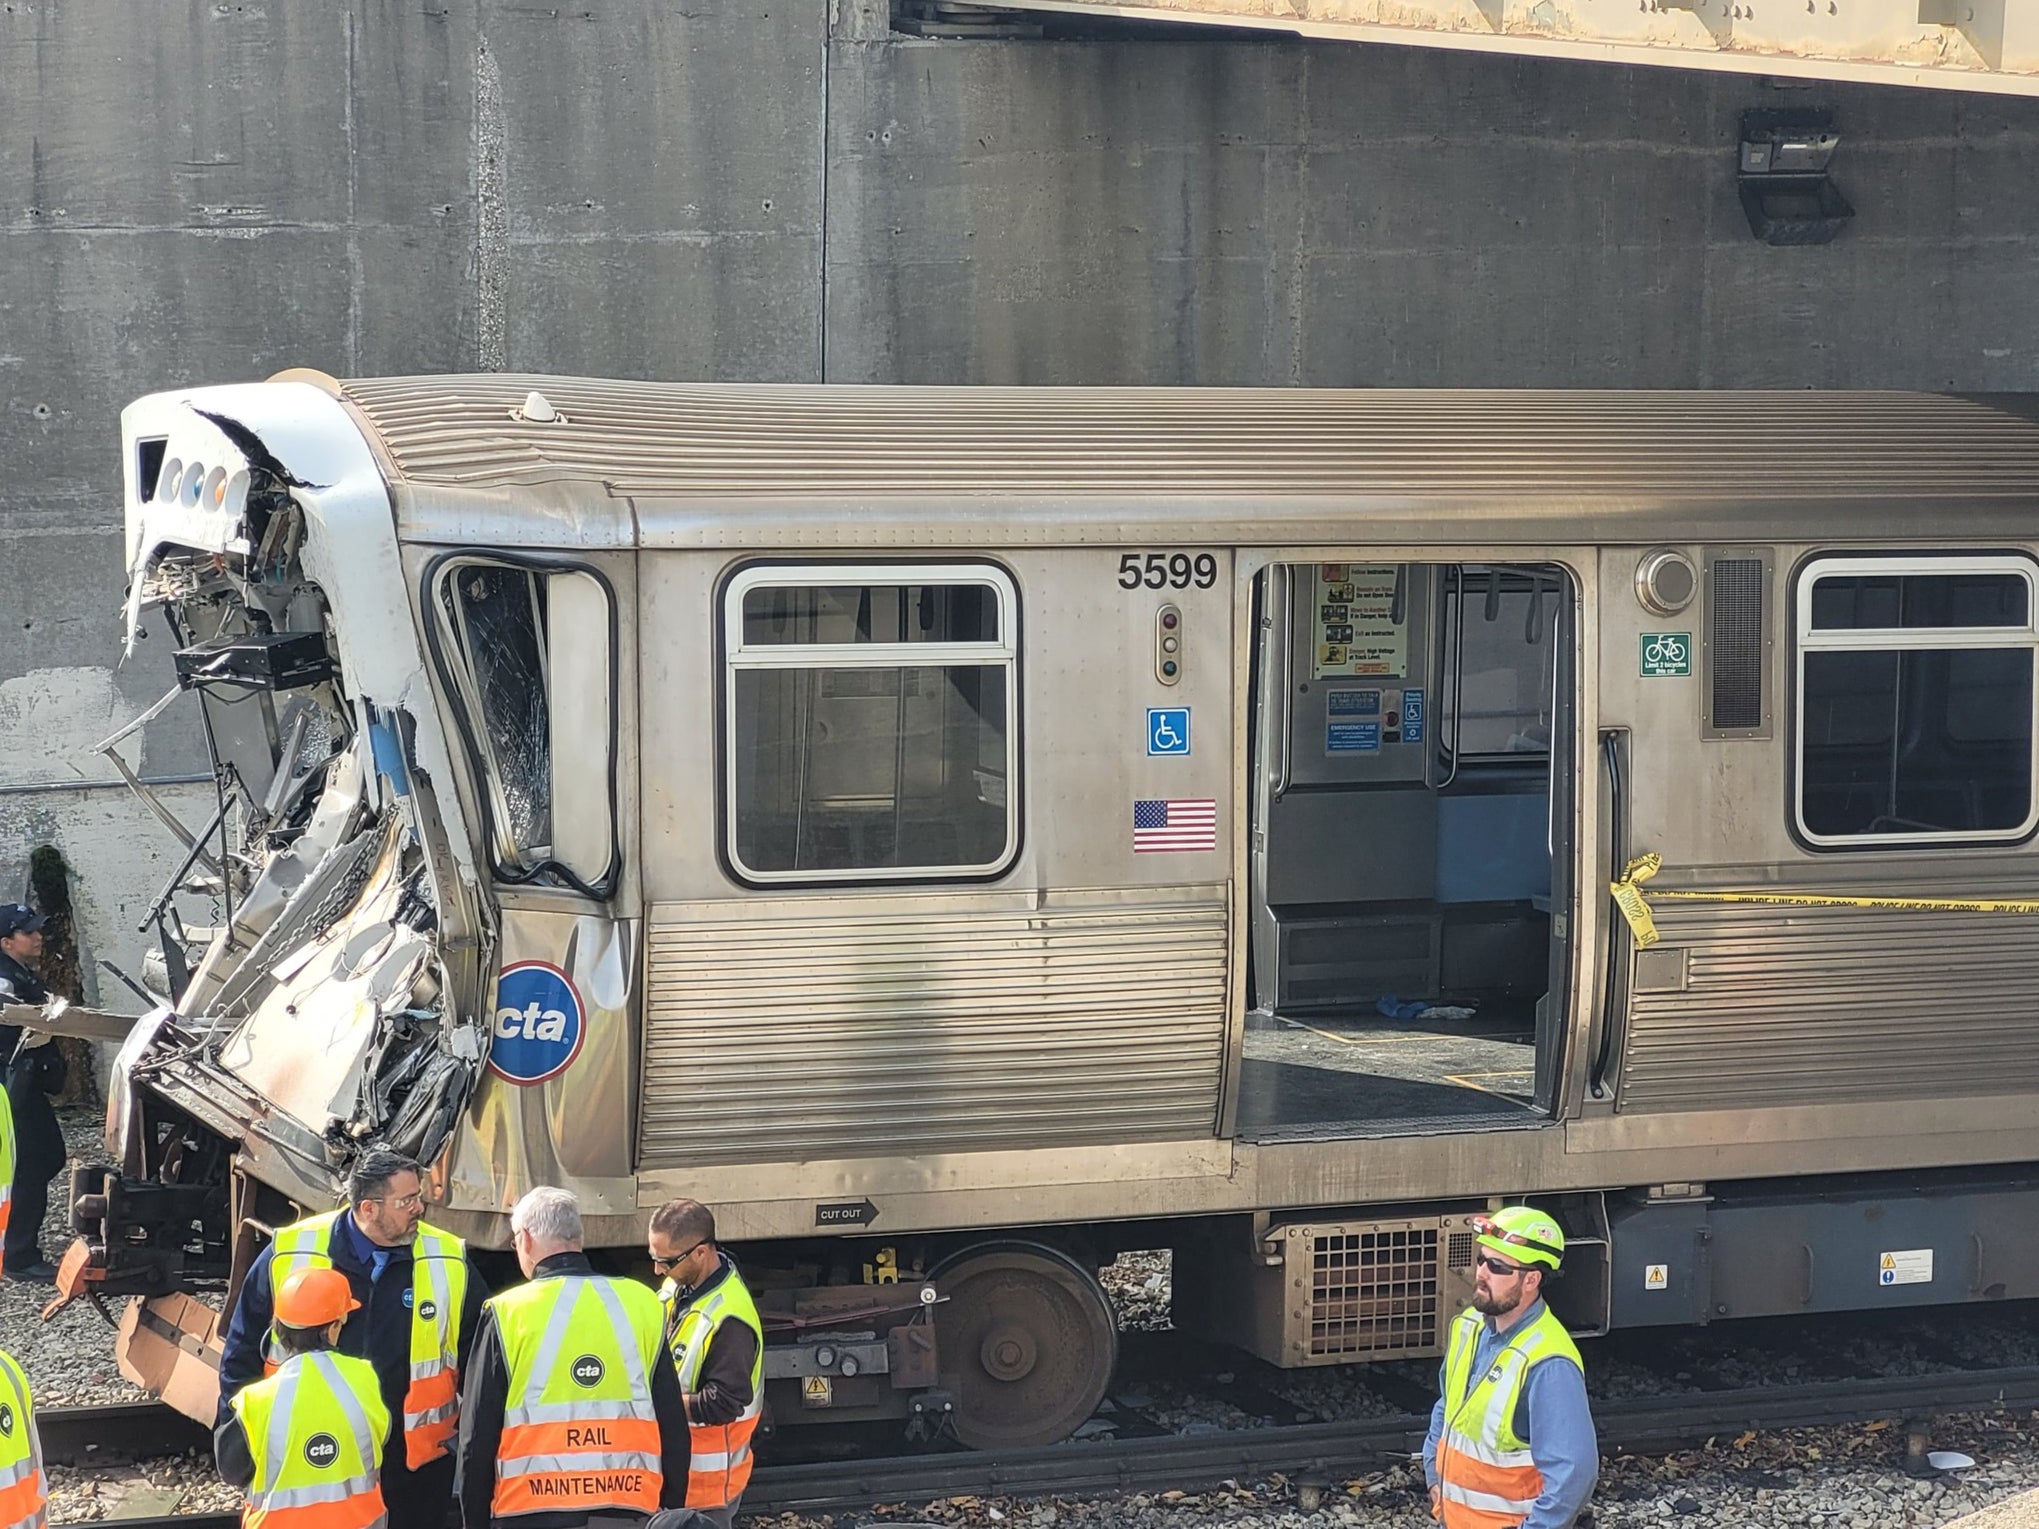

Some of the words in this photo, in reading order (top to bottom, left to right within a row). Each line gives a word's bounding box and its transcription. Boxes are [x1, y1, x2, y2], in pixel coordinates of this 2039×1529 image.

[1118, 553, 1217, 589] 5599
[494, 1002, 566, 1042] cta
[820, 1210, 840, 1220] CUT
[842, 1209, 861, 1219] OUT
[421, 1306, 435, 1315] cta
[576, 1366, 599, 1377] cta
[566, 1428, 612, 1447] RAIL
[310, 1443, 334, 1456] cta
[529, 1475, 642, 1495] MAINTENANCE
